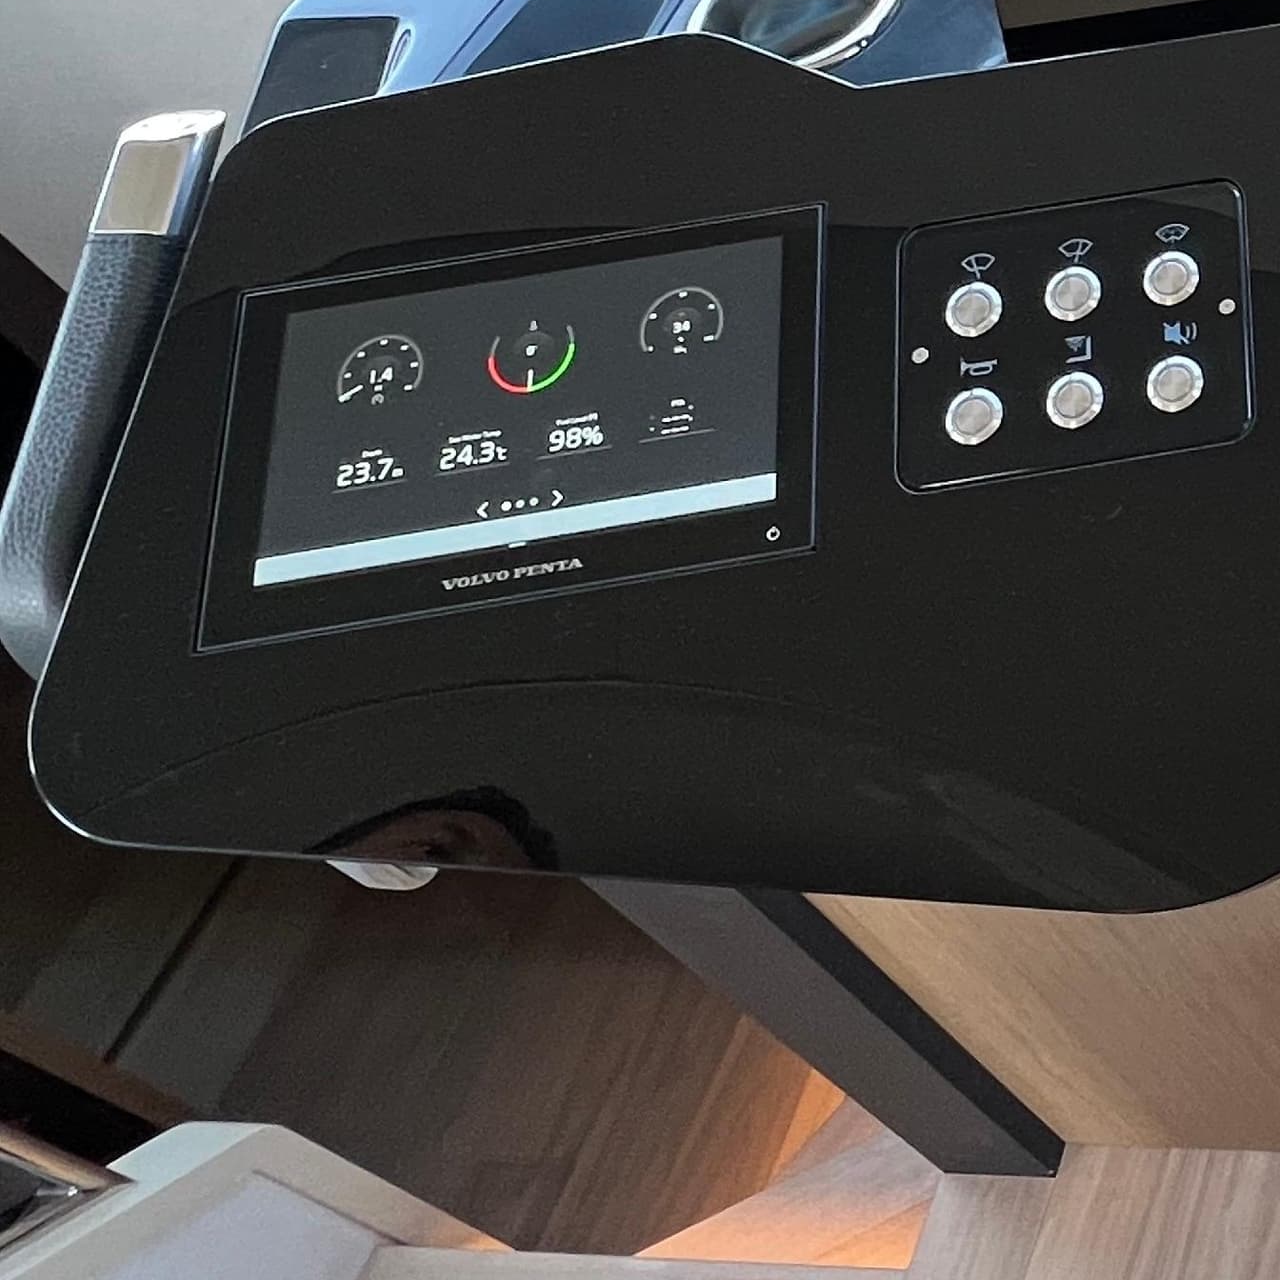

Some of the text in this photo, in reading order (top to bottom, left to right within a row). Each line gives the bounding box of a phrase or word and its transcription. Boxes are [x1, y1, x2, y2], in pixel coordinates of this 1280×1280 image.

[549, 424, 604, 453] 98%
[440, 557, 584, 591] VOLVO PENTA
